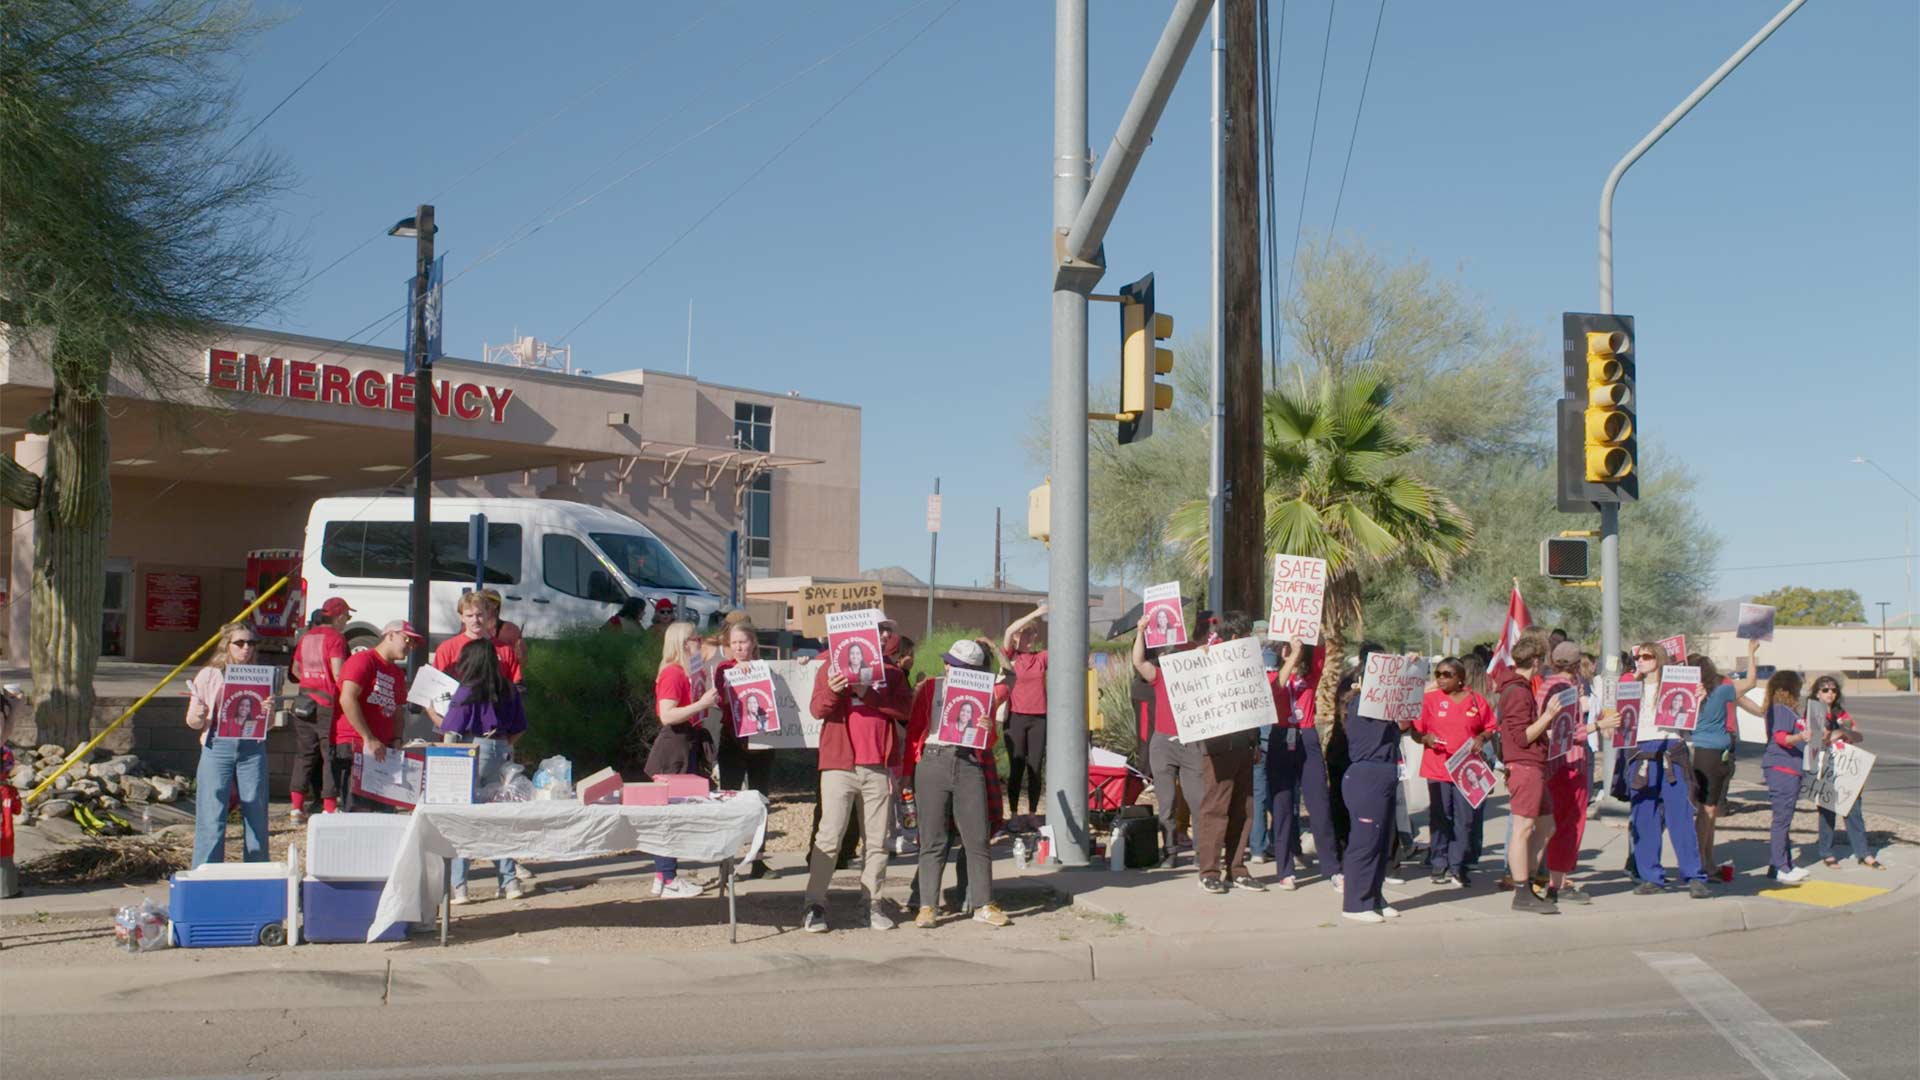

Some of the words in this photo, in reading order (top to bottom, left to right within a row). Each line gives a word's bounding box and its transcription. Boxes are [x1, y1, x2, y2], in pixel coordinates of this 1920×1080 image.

[207, 348, 515, 424] EMERGENCY
[1279, 559, 1323, 580] SAFE
[804, 587, 839, 601] SAVE
[842, 585, 878, 600] LIVES
[1274, 579, 1323, 596] STAFFING
[807, 602, 835, 617] NOT
[1272, 594, 1321, 616] SAVES
[829, 620, 874, 631] DOMINIQUE
[830, 612, 871, 622] REINSTATE
[1271, 614, 1318, 639] LIVES
[230, 666, 269, 674] REINSTATE
[1367, 654, 1405, 674] STOP
[227, 675, 270, 683] DOMINIQUE
[950, 678, 990, 689] DOMINIQUE
[952, 670, 990, 681] REINSTATE
[1169, 675, 1211, 698] MIGHT
[1363, 687, 1414, 704] AGAINST
[1174, 703, 1187, 714] BE
[1194, 695, 1213, 708] THE
[1382, 702, 1423, 721] NURSES
[1182, 700, 1238, 729] GREATEST
